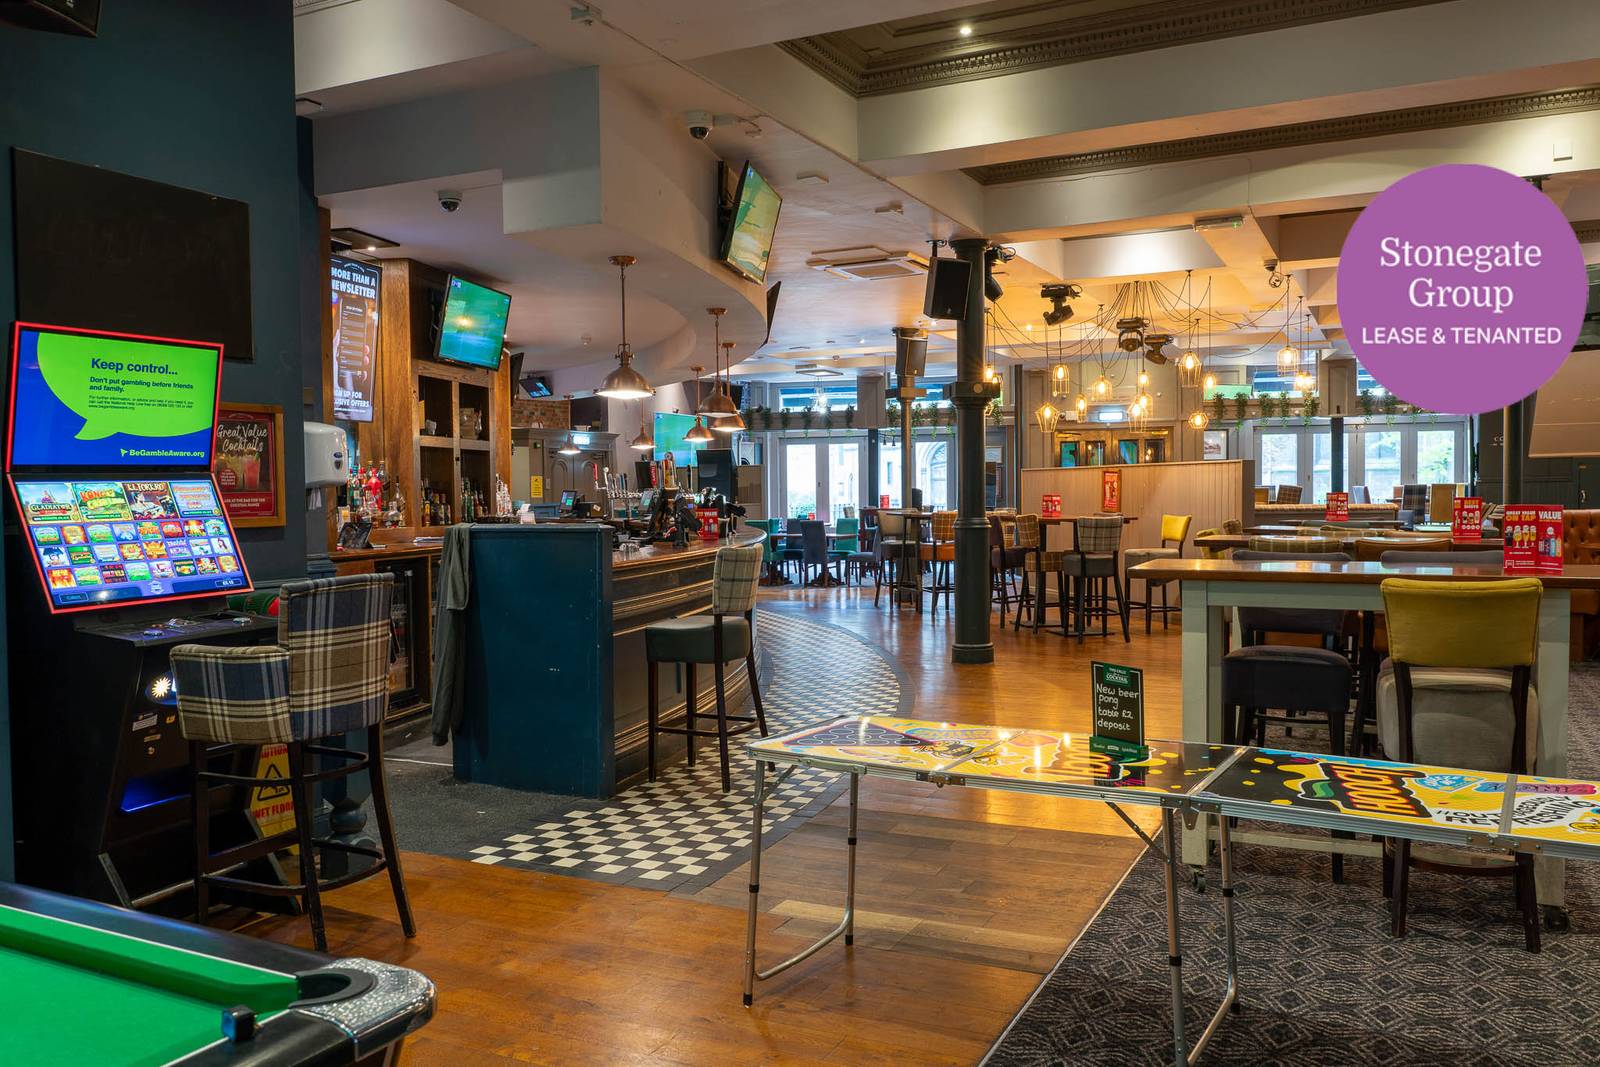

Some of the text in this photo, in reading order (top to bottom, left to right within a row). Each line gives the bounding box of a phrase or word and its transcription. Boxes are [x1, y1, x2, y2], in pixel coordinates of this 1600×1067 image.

[331, 267, 351, 280] MORE
[352, 272, 370, 285] THAN
[371, 278, 376, 287] A
[91, 358, 178, 375] Keep control...
[90, 376, 108, 384] Don't
[122, 379, 151, 388] gambling
[172, 382, 194, 390] friends
[217, 424, 268, 438] Great Value
[222, 437, 264, 452] Cocktails
[129, 449, 205, 458] BeGambleAware.org
[1538, 511, 1562, 520] VALUE
[1096, 684, 1140, 698] New beer
[1098, 694, 1118, 710] pong
[1098, 707, 1119, 718] table
[1097, 718, 1131, 730] deposit
[1330, 764, 1421, 817] HOOCH
